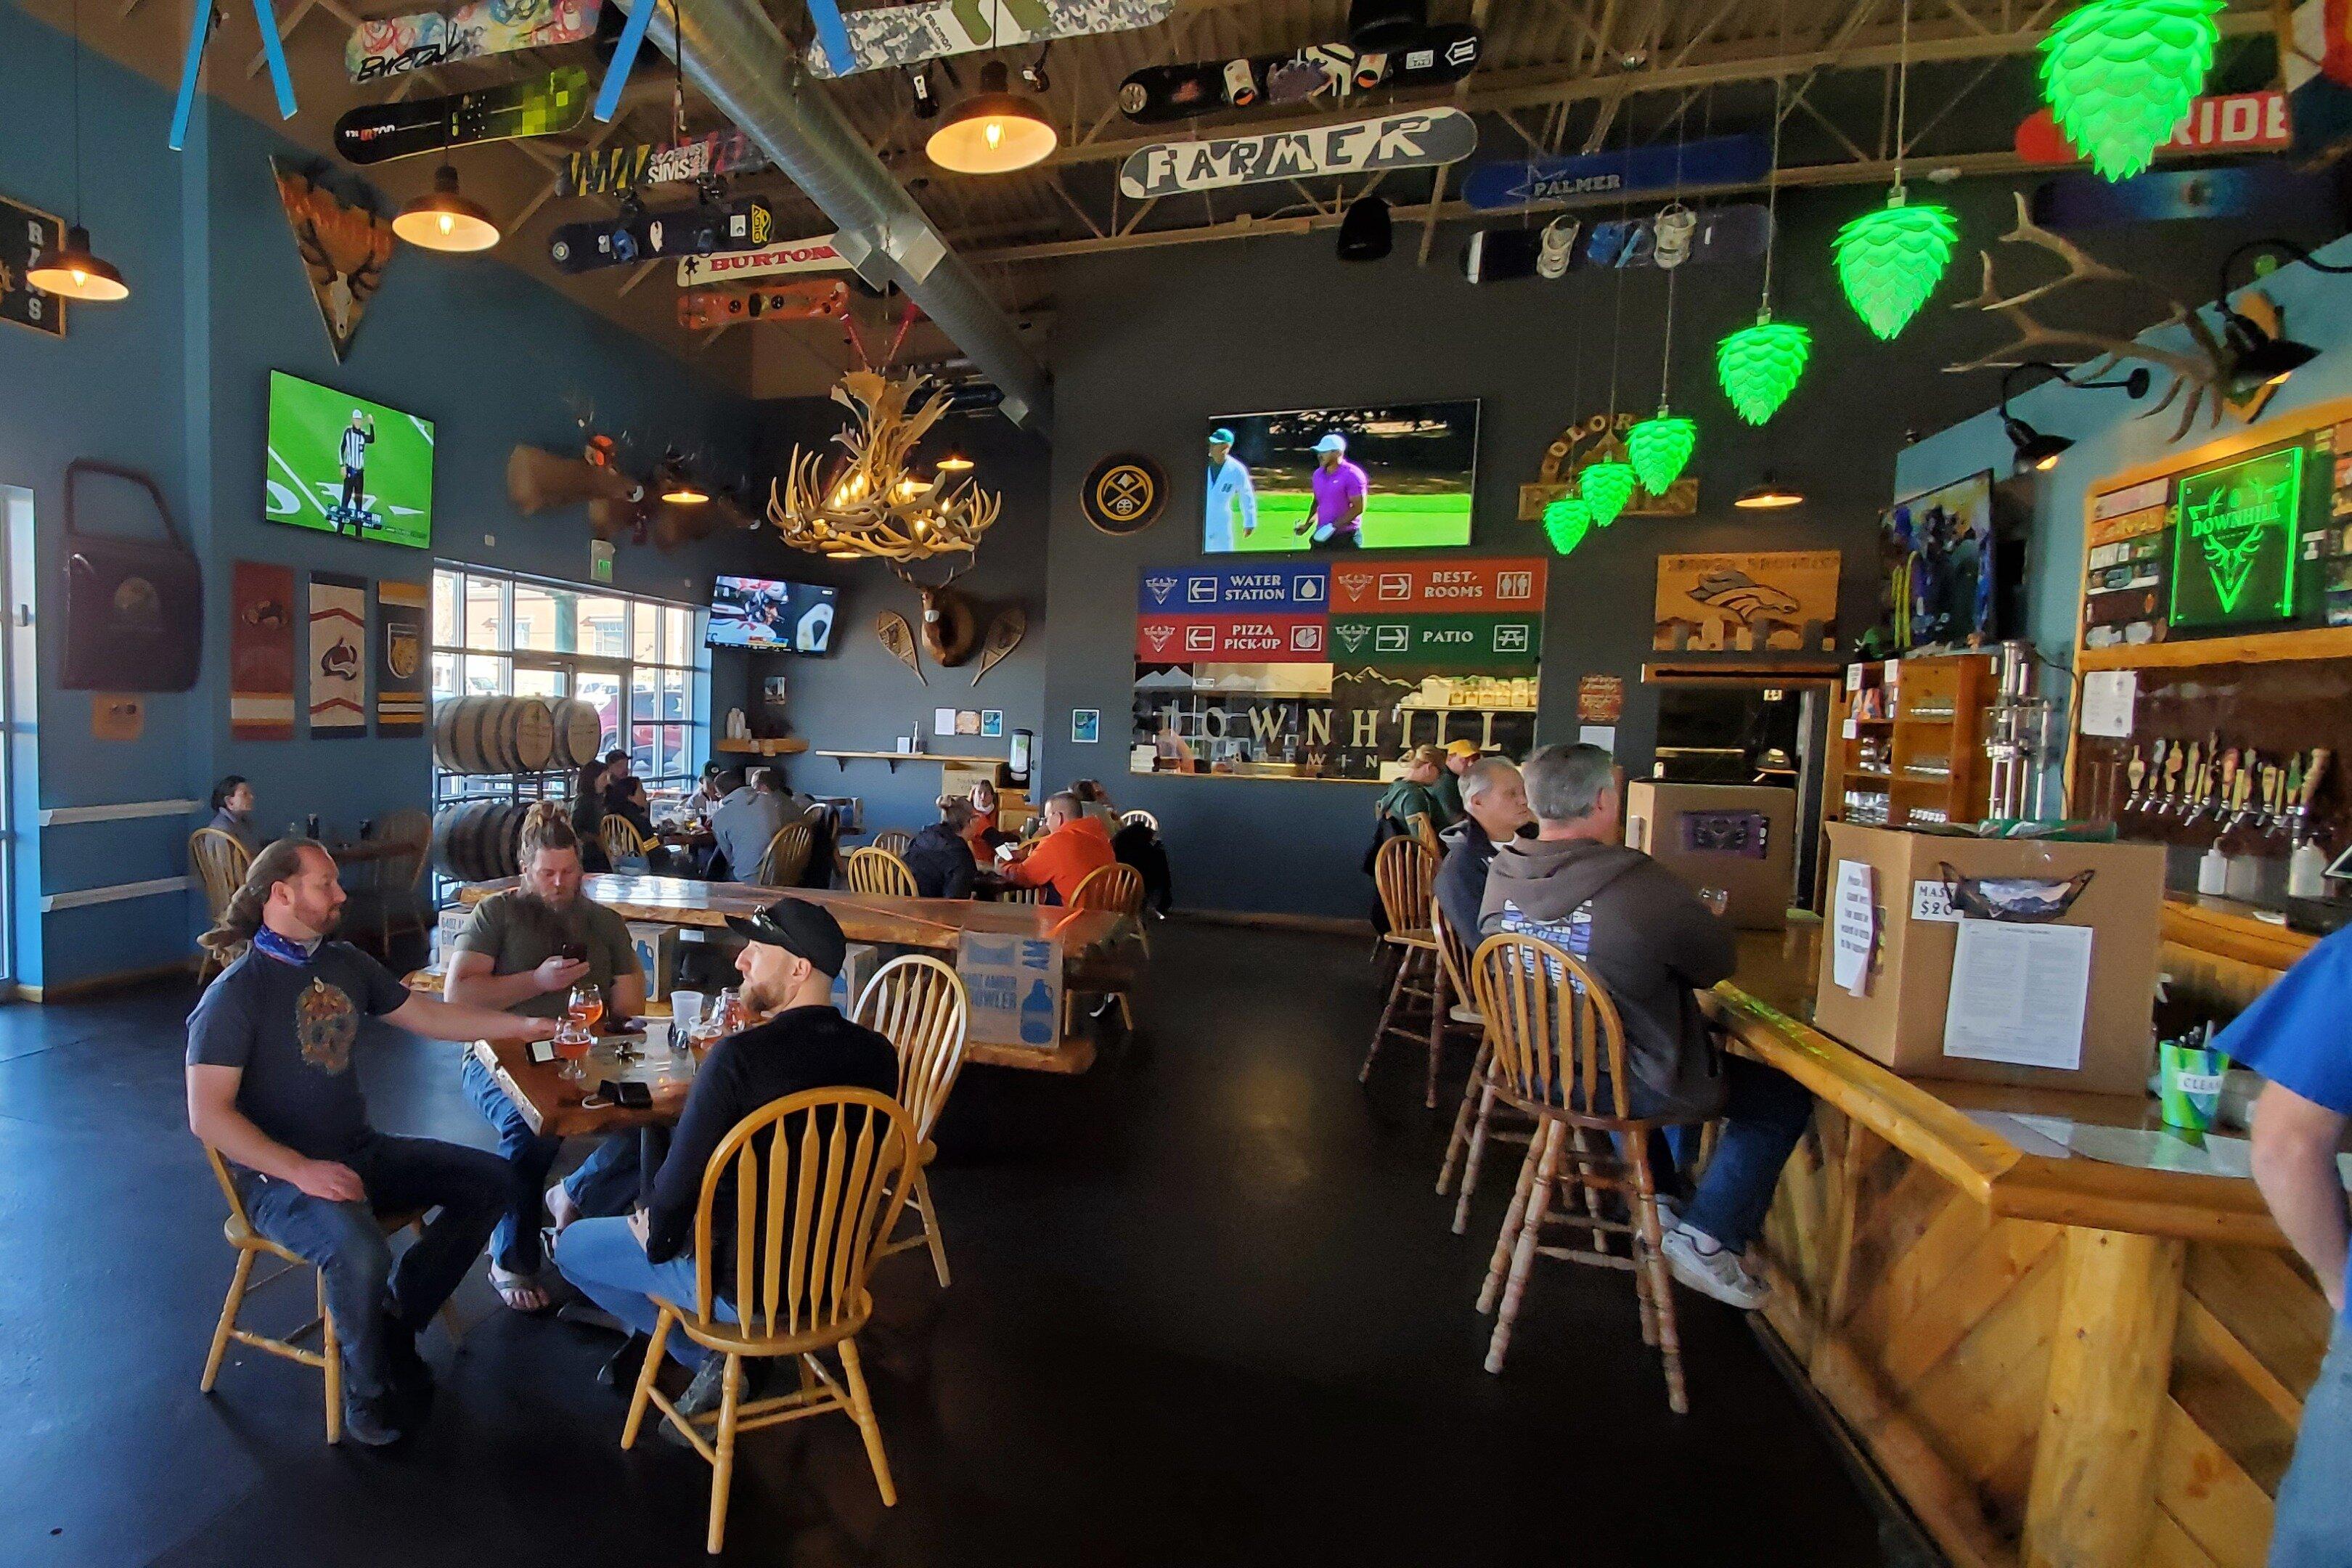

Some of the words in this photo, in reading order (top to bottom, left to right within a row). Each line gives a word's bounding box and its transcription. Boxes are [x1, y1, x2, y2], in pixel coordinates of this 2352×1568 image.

[1146, 116, 1432, 190] FARMER
[648, 158, 691, 184] SIMS
[1533, 173, 1620, 197] PALMER
[710, 245, 841, 272] BURTON
[1230, 574, 1281, 587] WATER
[1432, 571, 1478, 584] REST-
[1224, 589, 1285, 601] STATION
[1424, 586, 1483, 598] ROOMS
[1232, 624, 1275, 636] PIZZA
[1422, 630, 1474, 643] PATIO
[1224, 638, 1281, 650] PICK-UP
[1920, 900, 1953, 916] $20
